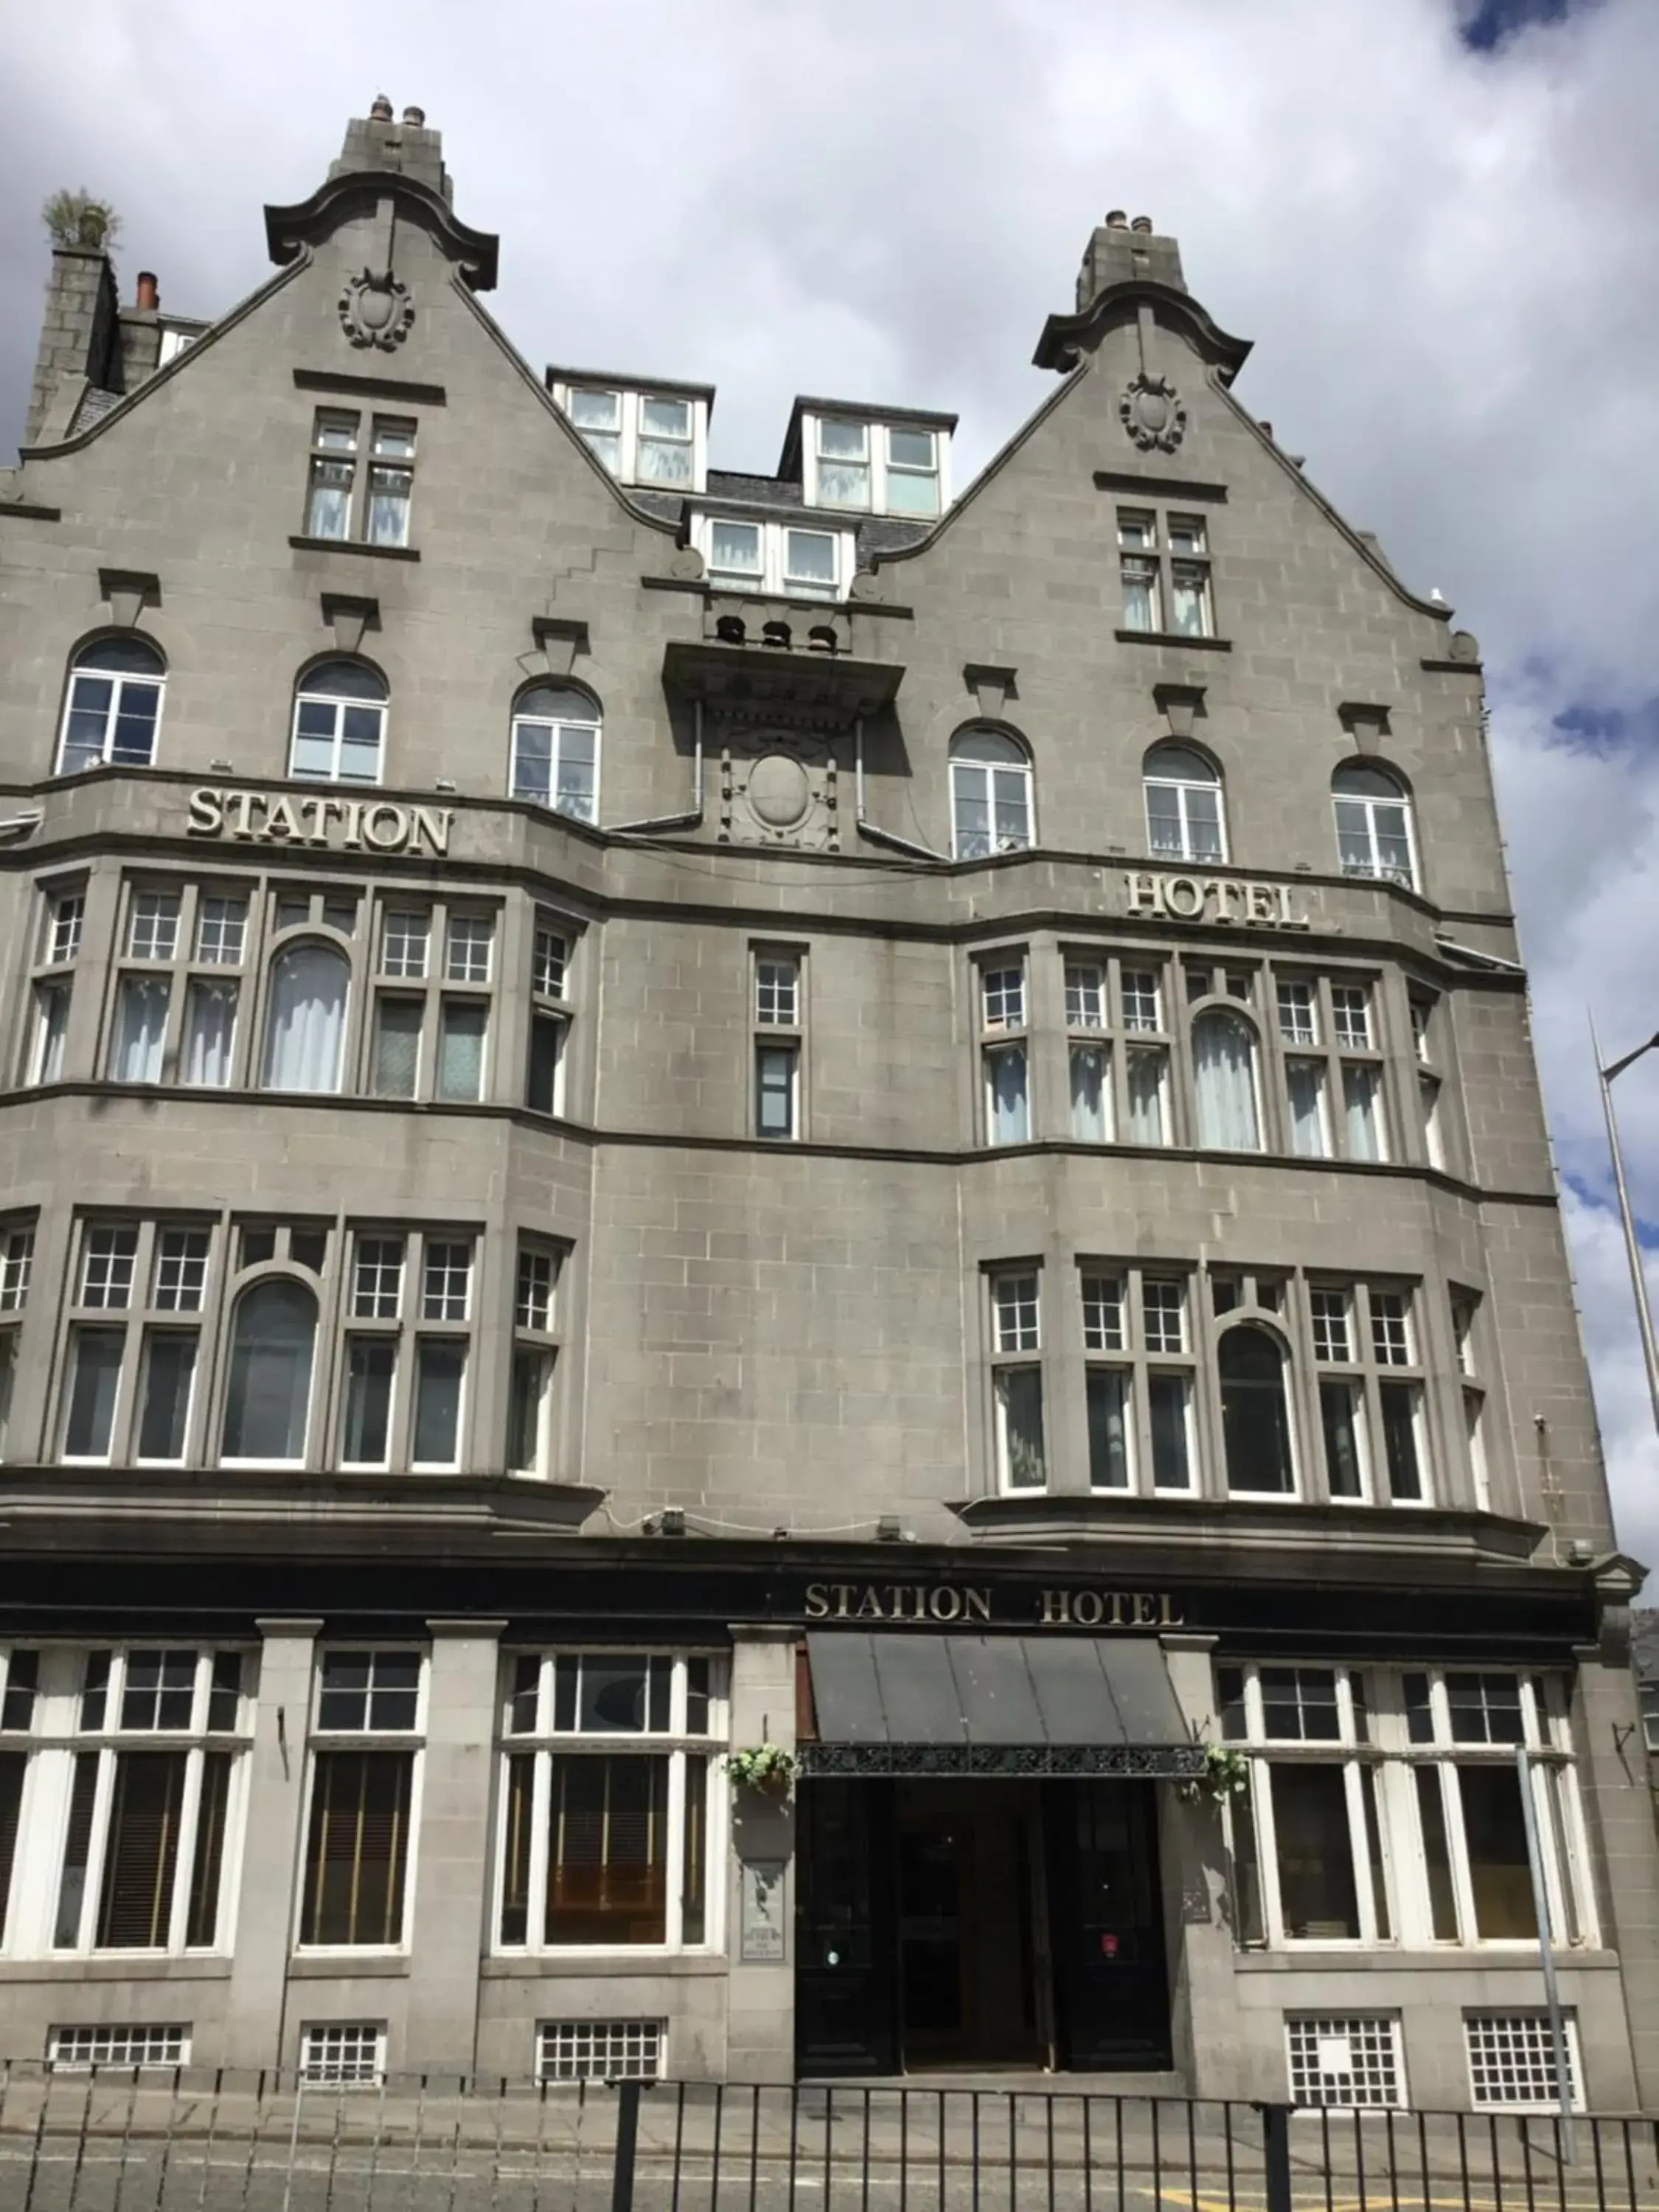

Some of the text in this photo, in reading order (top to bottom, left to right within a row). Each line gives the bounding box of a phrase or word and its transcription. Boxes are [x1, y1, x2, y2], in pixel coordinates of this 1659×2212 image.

[187, 787, 453, 854] STATION
[1124, 872, 1310, 928] HOTEL
[804, 1583, 1184, 1626] STATION HOTEL
